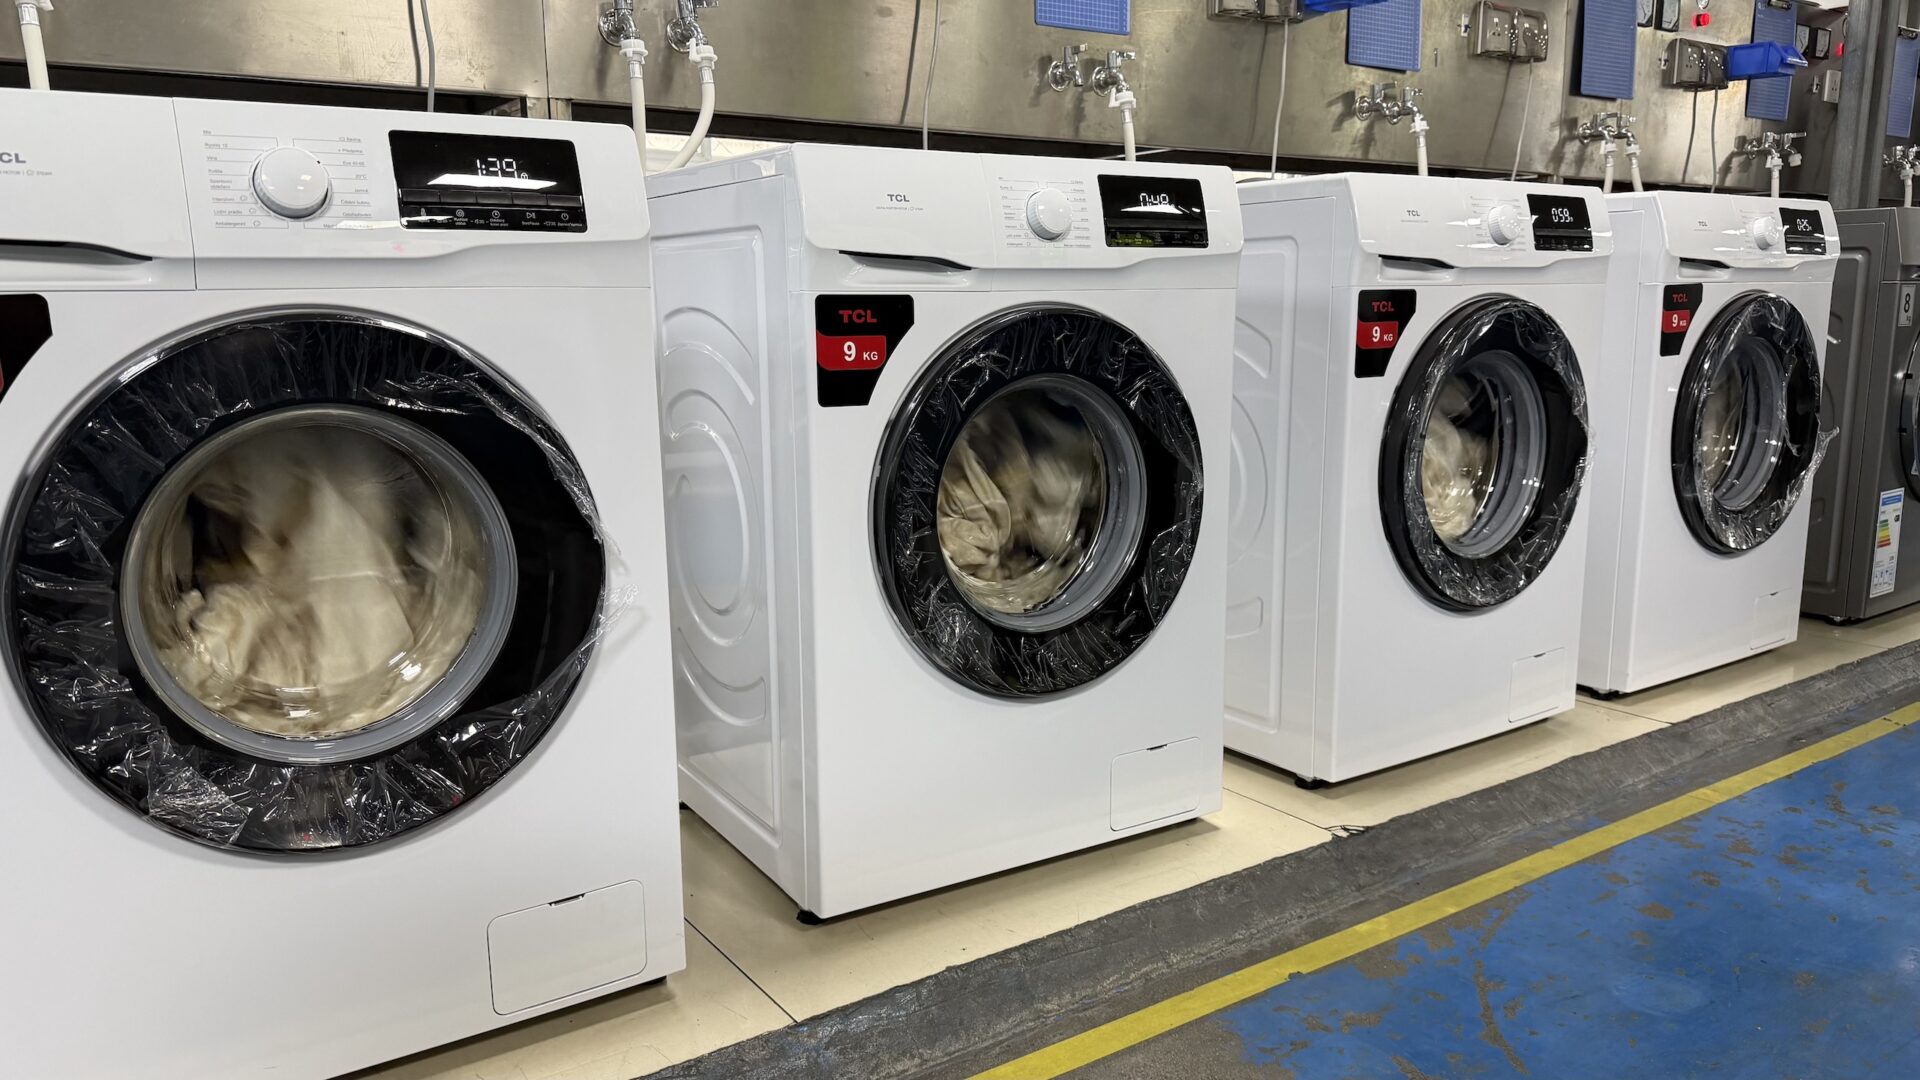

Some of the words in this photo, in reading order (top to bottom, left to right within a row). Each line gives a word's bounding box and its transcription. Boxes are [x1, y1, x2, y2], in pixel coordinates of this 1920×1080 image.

[0, 152, 26, 163] CL
[477, 158, 517, 178] 1:39
[887, 194, 910, 202] TCL
[1672, 293, 1688, 303] TCL
[1903, 292, 1911, 313] 8
[1372, 301, 1394, 312] TCL
[838, 309, 877, 323] TCL
[1672, 314, 1678, 327] 9
[1372, 326, 1381, 342] 9
[1383, 333, 1393, 342] KG
[843, 341, 856, 362] 9
[863, 351, 878, 361] KG
